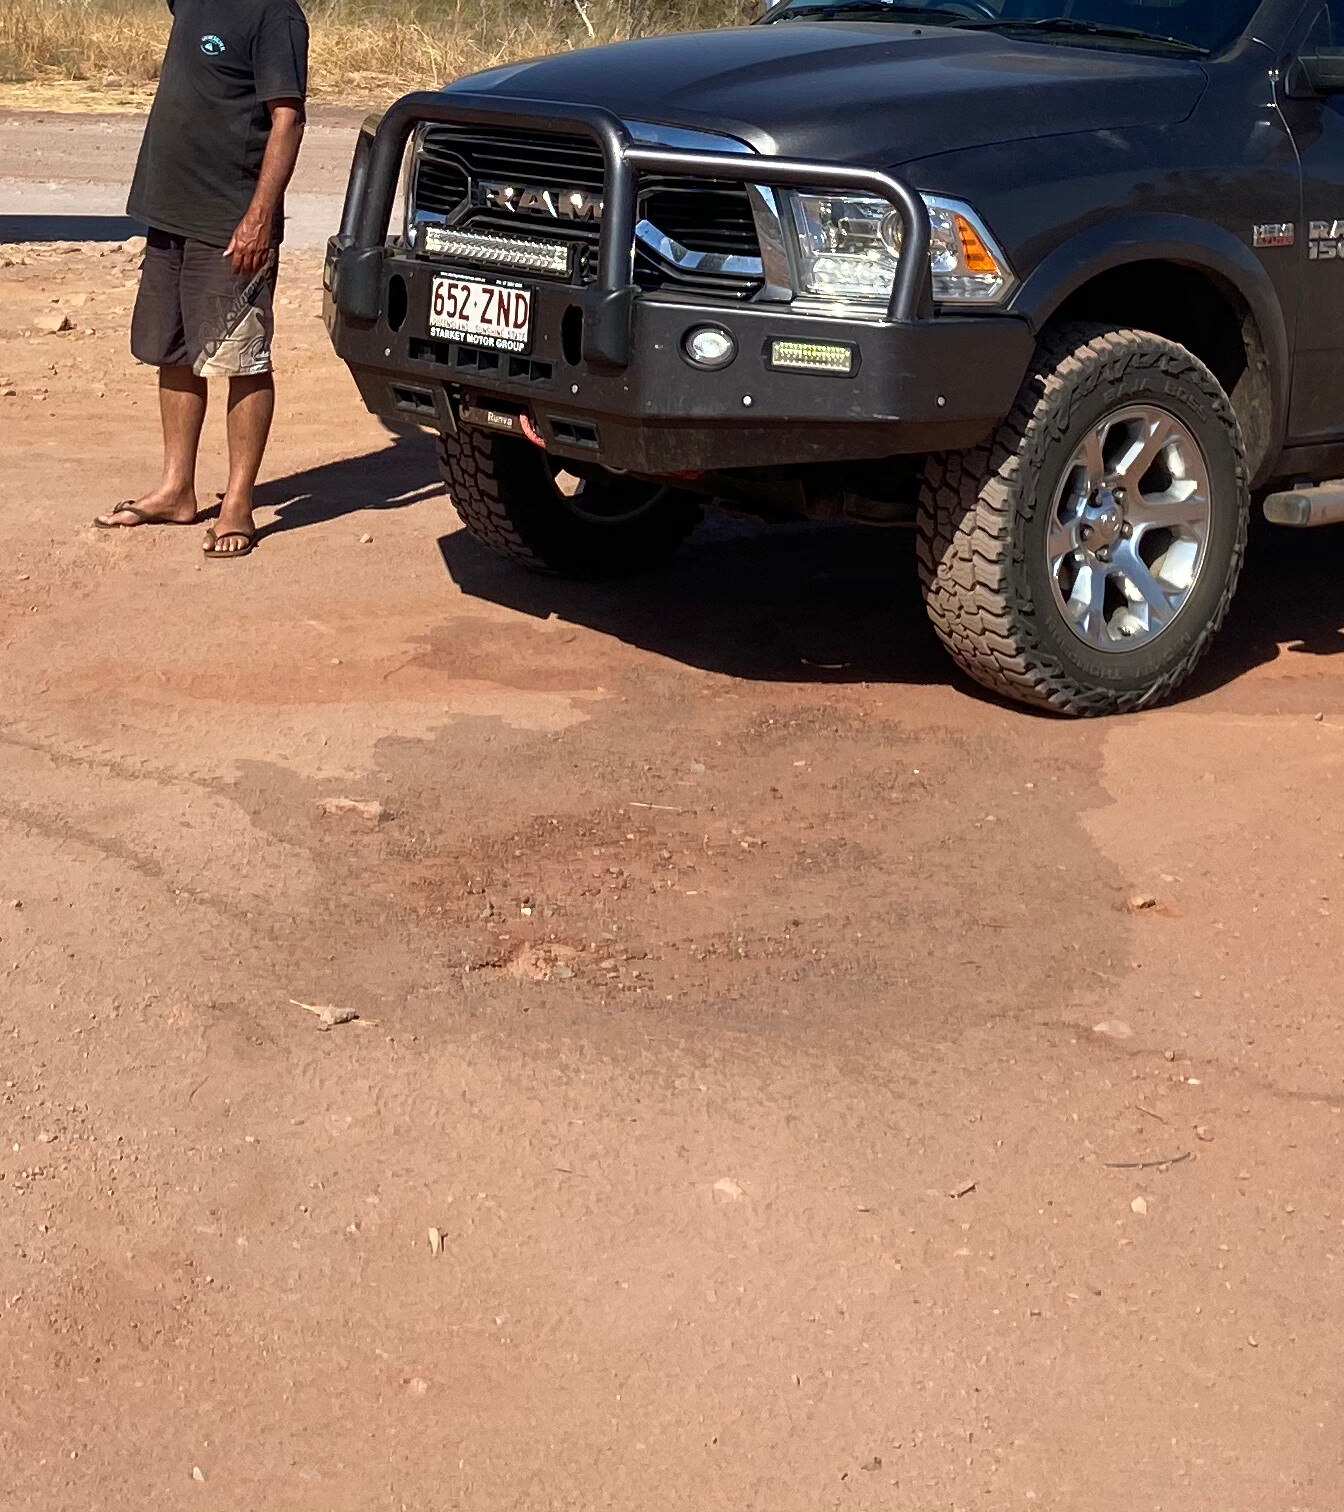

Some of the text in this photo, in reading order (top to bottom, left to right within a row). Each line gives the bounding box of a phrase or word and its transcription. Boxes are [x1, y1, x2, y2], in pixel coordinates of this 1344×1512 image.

[485, 186, 605, 222] RAM
[433, 281, 529, 330] 652 ZND
[430, 326, 525, 352] STARKET MOTOR GROUP
